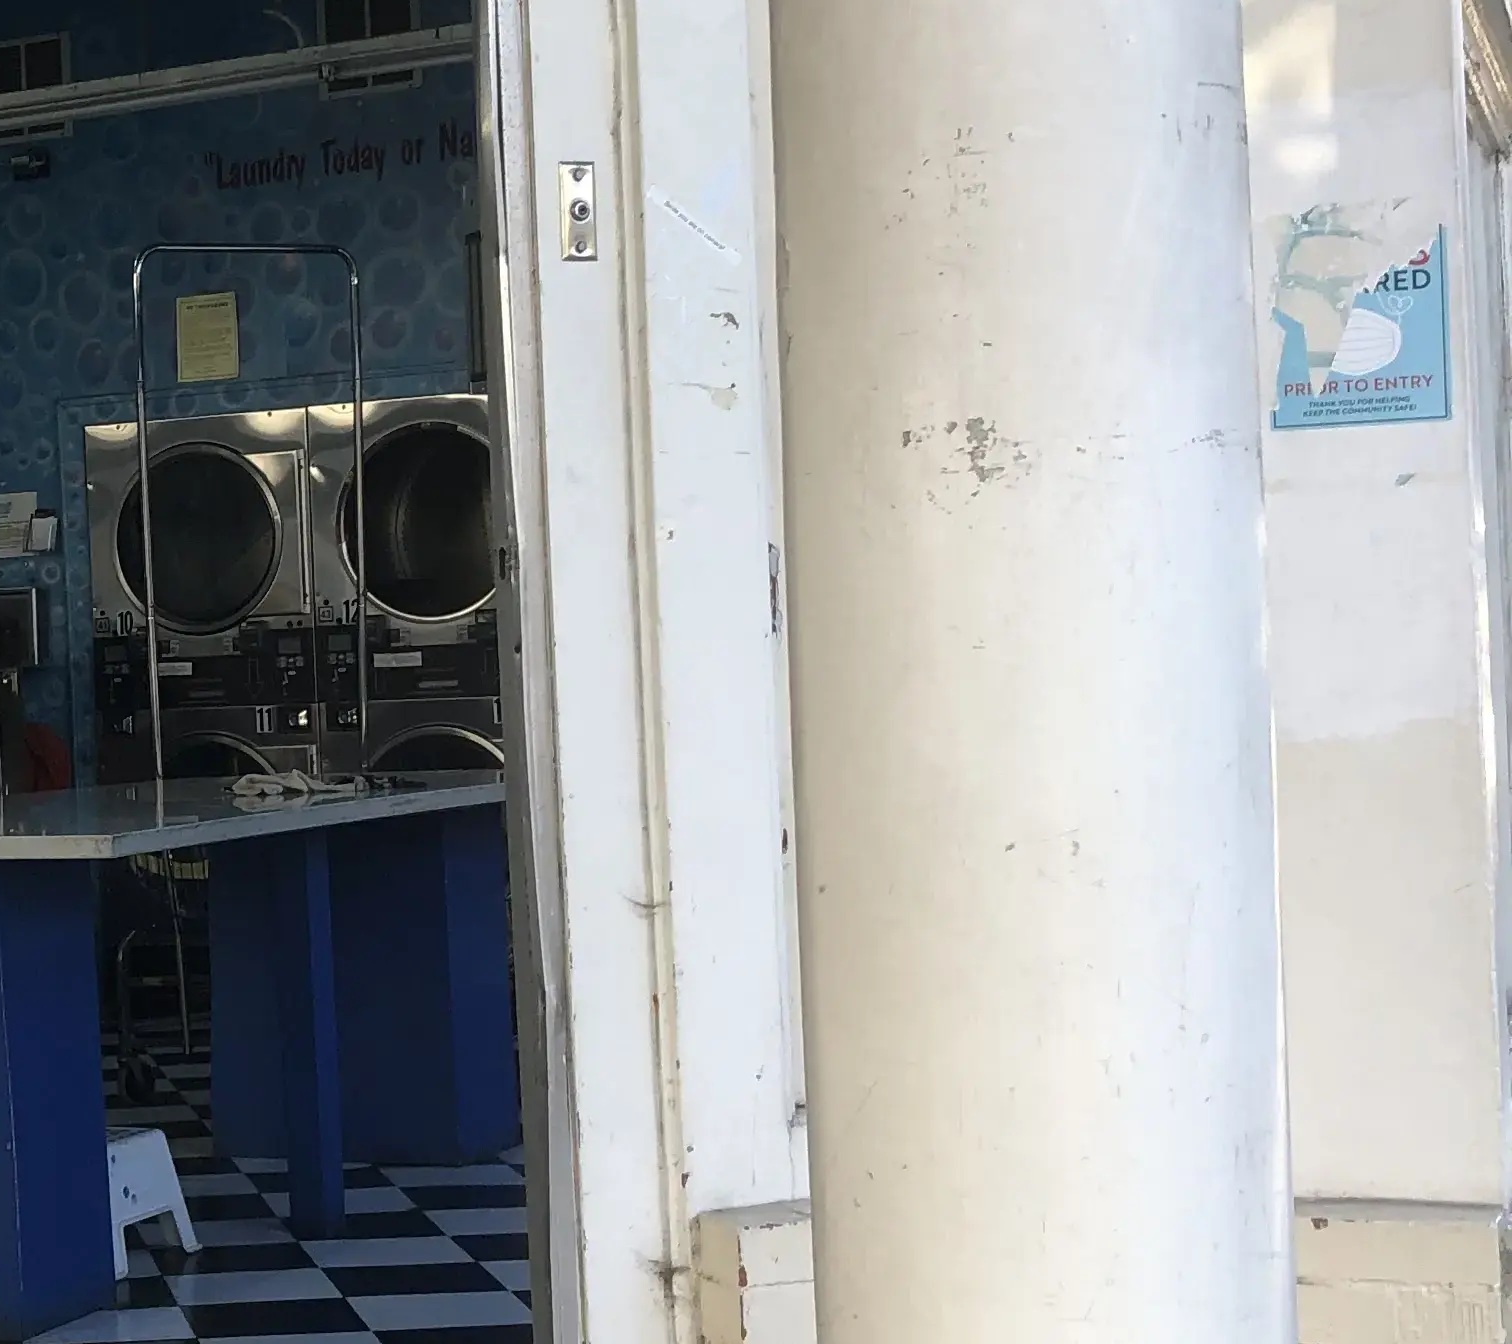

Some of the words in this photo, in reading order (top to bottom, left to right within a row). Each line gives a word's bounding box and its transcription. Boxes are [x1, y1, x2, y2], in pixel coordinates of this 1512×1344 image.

[320, 135, 386, 181] Today
[401, 137, 425, 164] or
[438, 117, 476, 161] Na
[1363, 269, 1431, 293] RED
[1344, 379, 1368, 392] TO
[1374, 374, 1433, 391] ENTRY
[1338, 399, 1355, 407] YOU
[118, 611, 133, 635] 10
[343, 599, 359, 624] 12
[257, 707, 272, 731] 11
